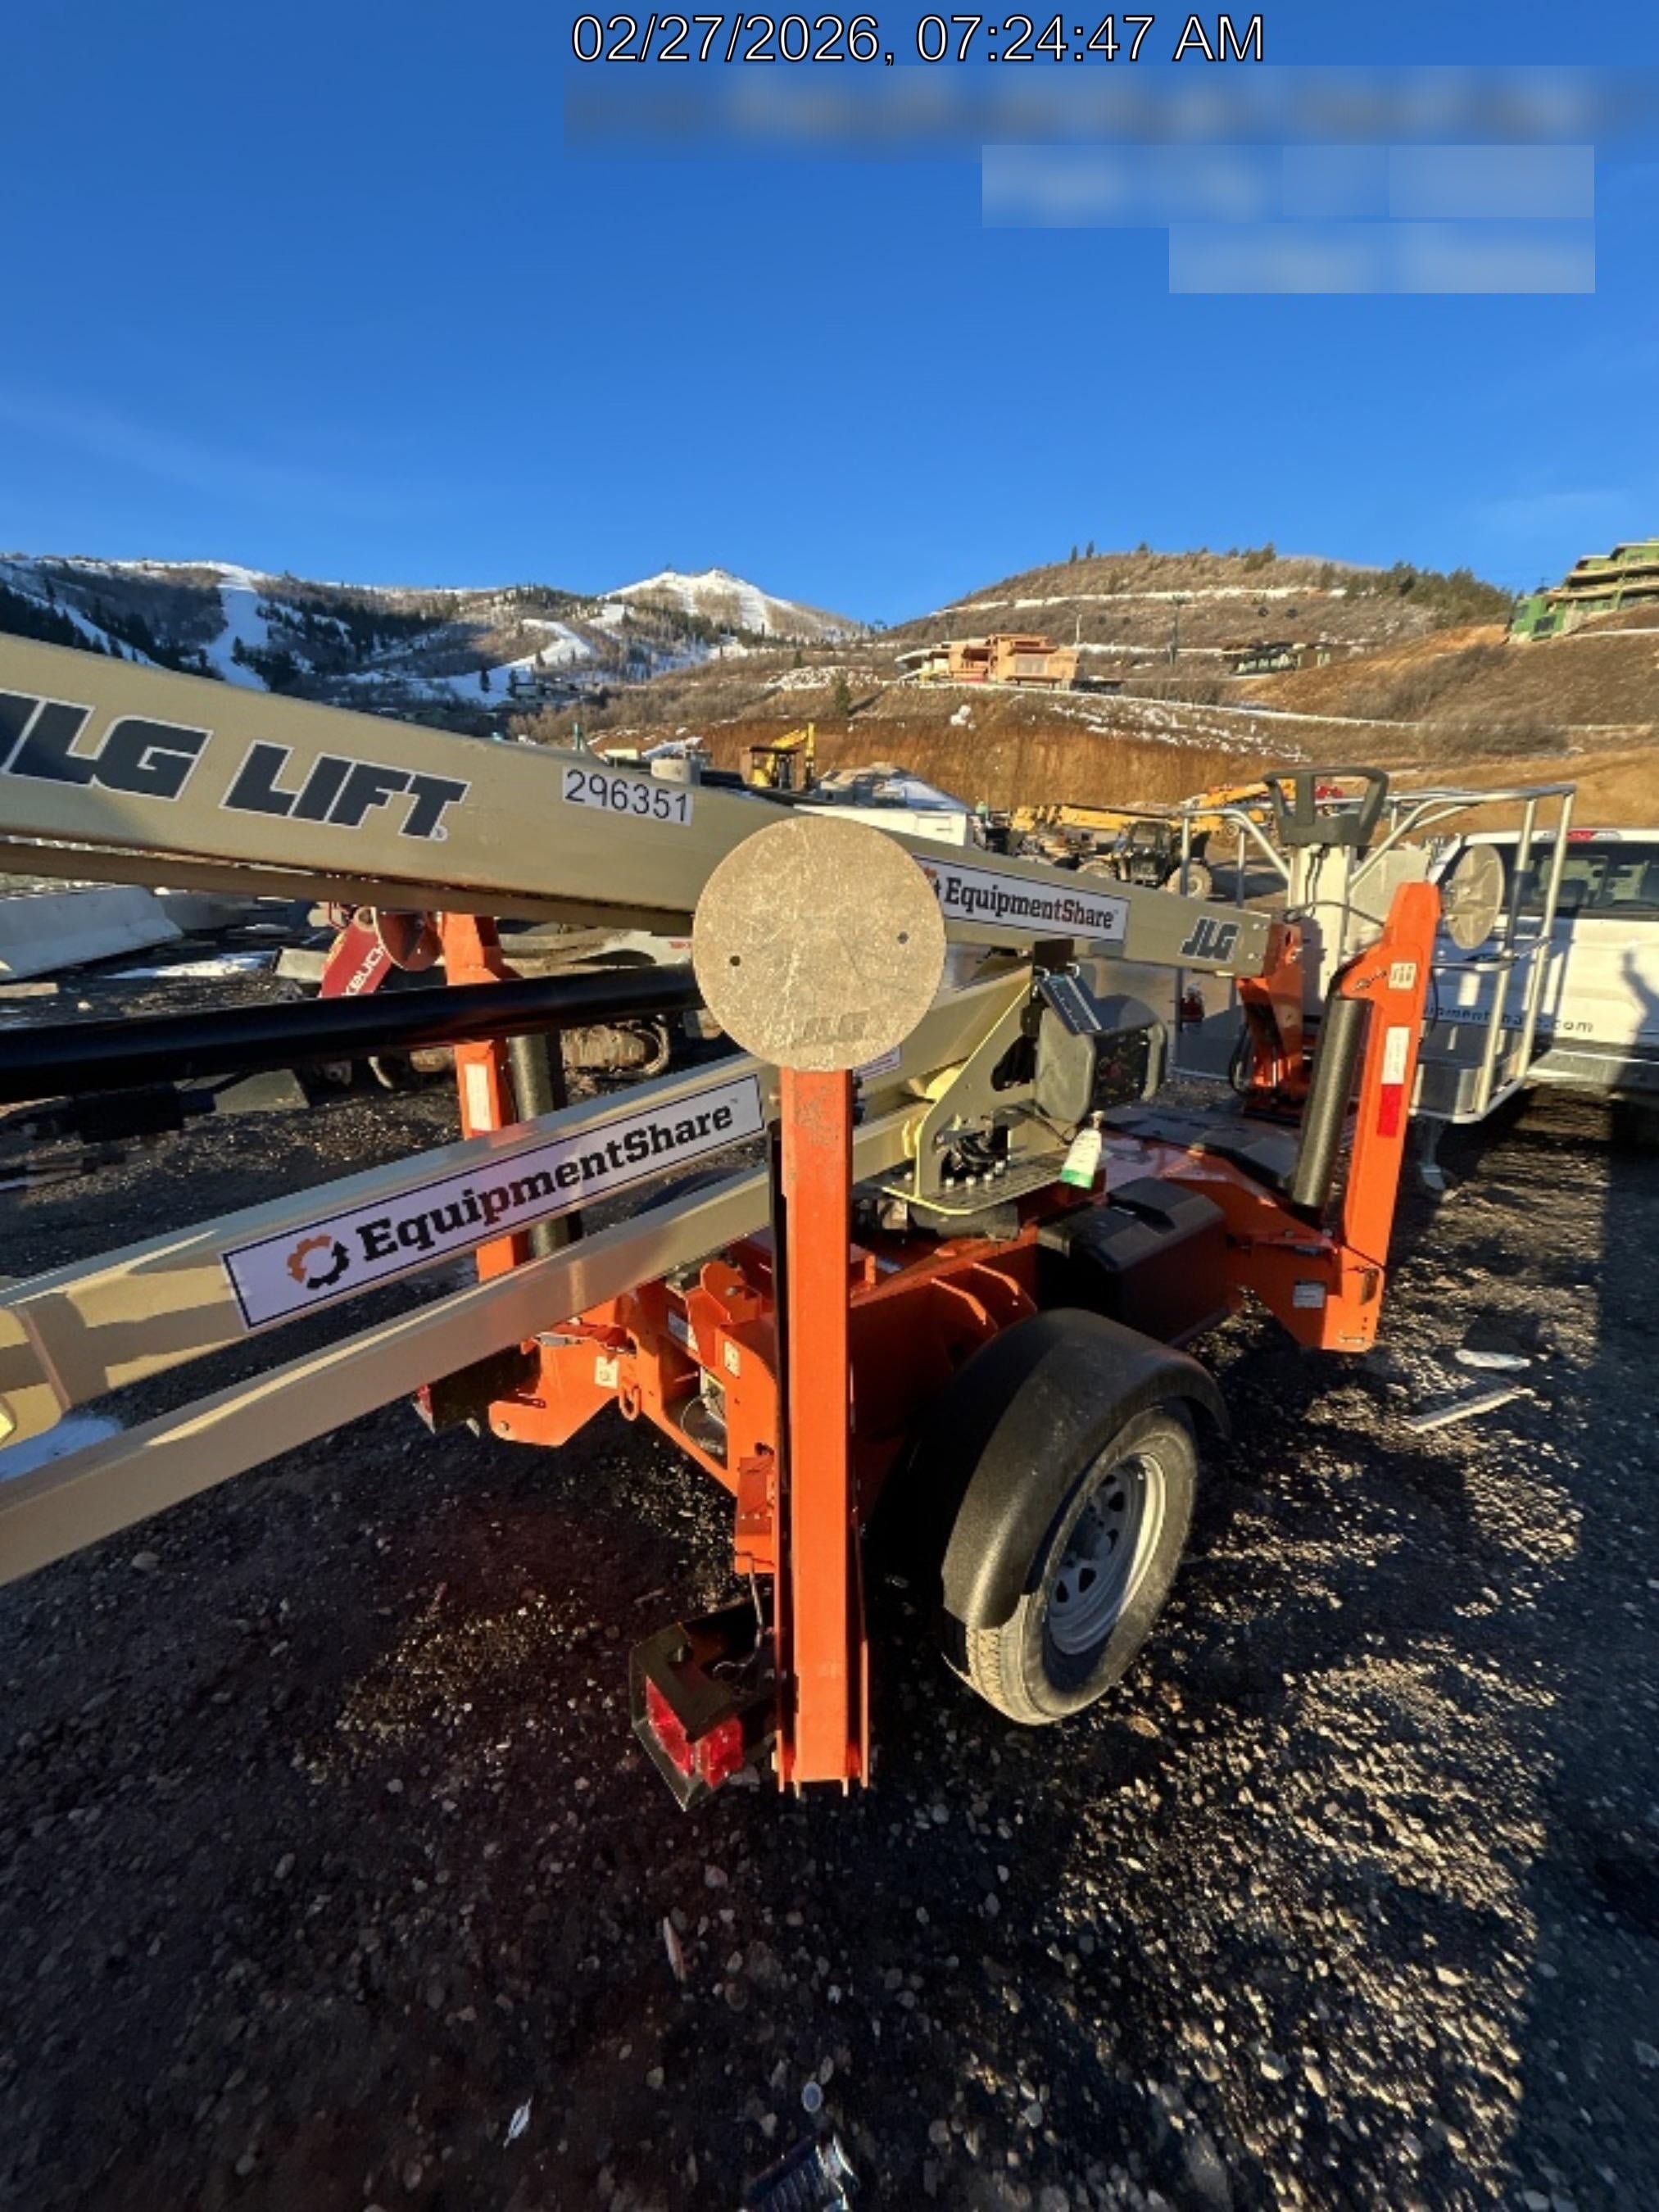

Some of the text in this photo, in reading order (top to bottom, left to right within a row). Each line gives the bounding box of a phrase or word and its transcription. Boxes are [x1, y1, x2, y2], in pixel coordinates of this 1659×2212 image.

[218, 740, 472, 841] LIFT
[564, 768, 688, 823] 296351
[944, 876, 1115, 930] EquipmentShare
[1180, 915, 1240, 962] JLG
[357, 1101, 733, 1262] EquipmentShare
